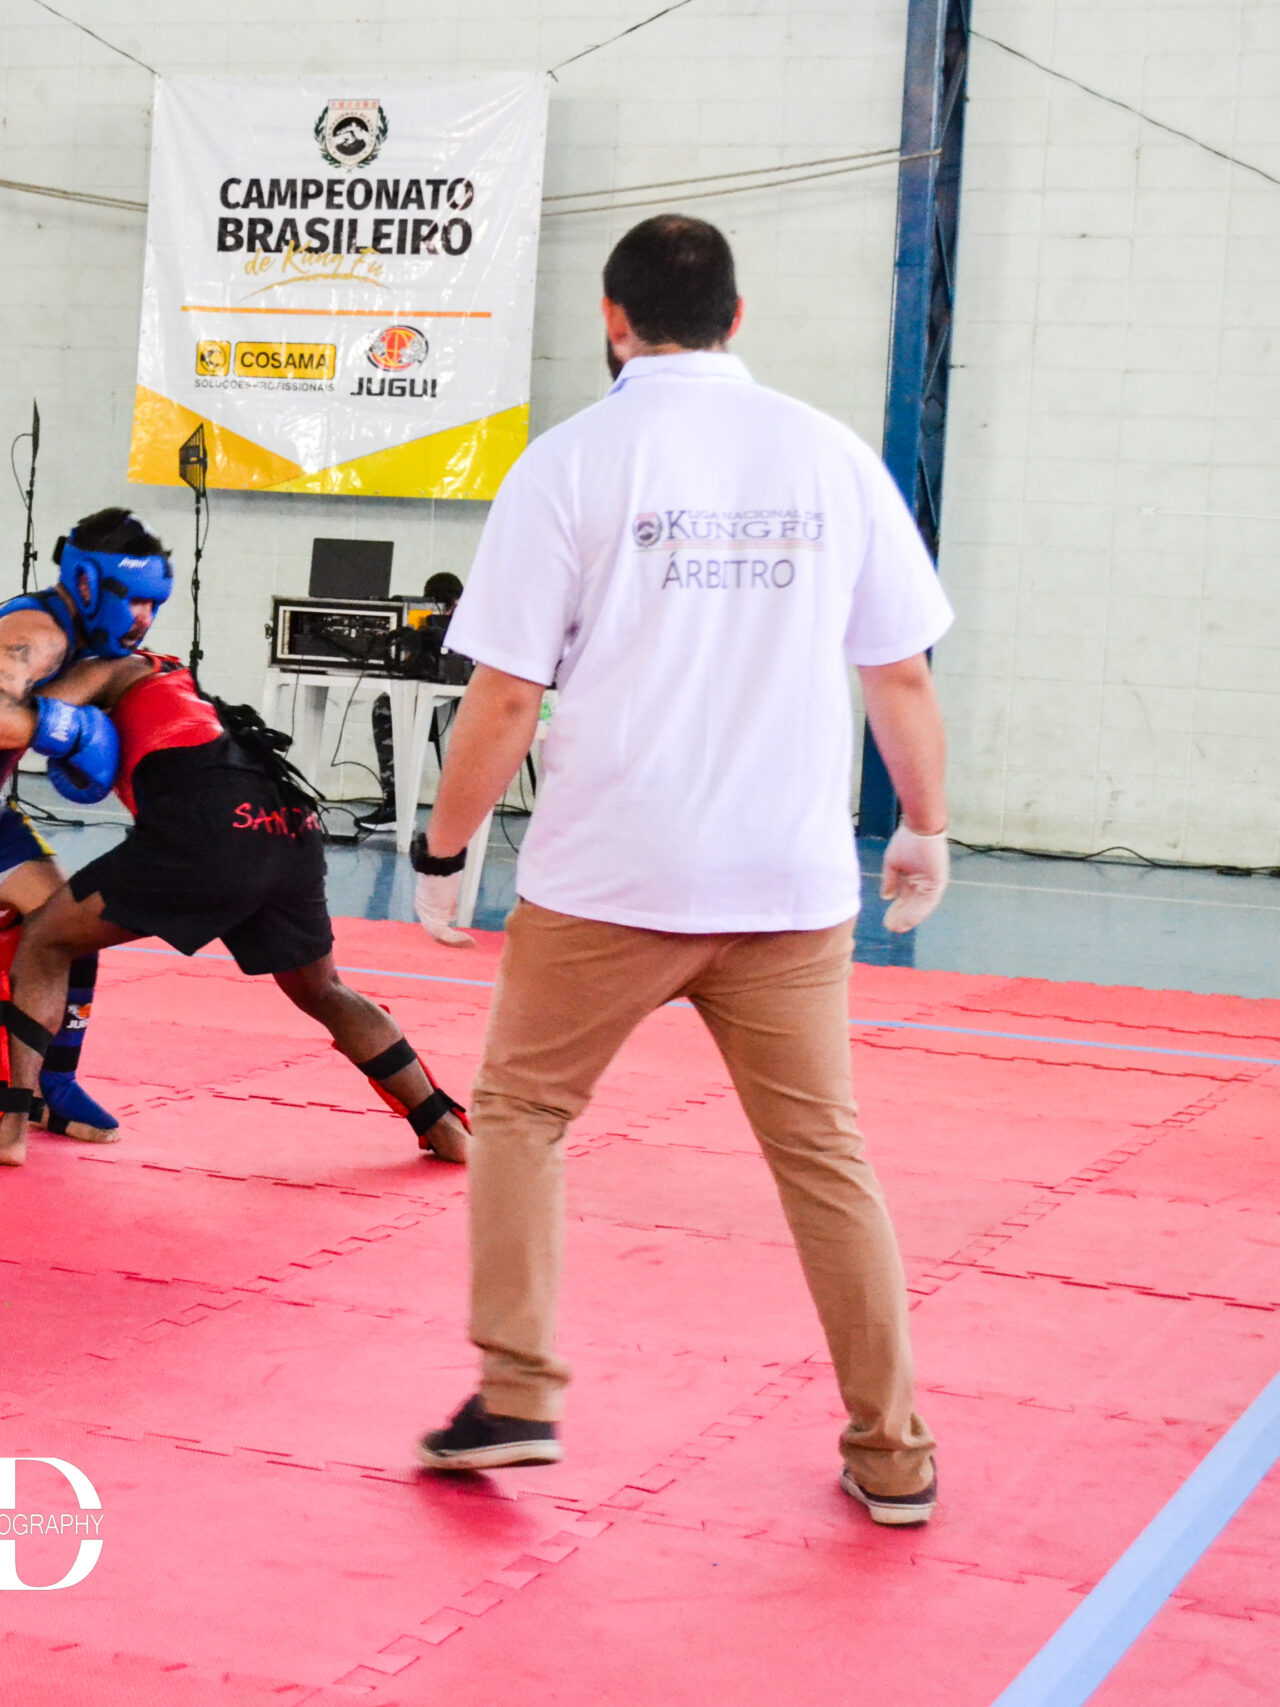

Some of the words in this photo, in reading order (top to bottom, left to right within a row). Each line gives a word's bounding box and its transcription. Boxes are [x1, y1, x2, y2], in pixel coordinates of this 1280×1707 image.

[219, 177, 475, 211] CAMPEONATO
[216, 216, 473, 256] BRASILEIRO
[243, 247, 273, 276] de
[280, 239, 345, 275] Kung
[350, 247, 385, 277] Fu
[240, 351, 330, 371] COSAMA
[350, 376, 438, 398] JUGUI
[663, 510, 772, 540] KUNG
[779, 520, 824, 541] FU
[661, 551, 796, 590] ÁRBITRO
